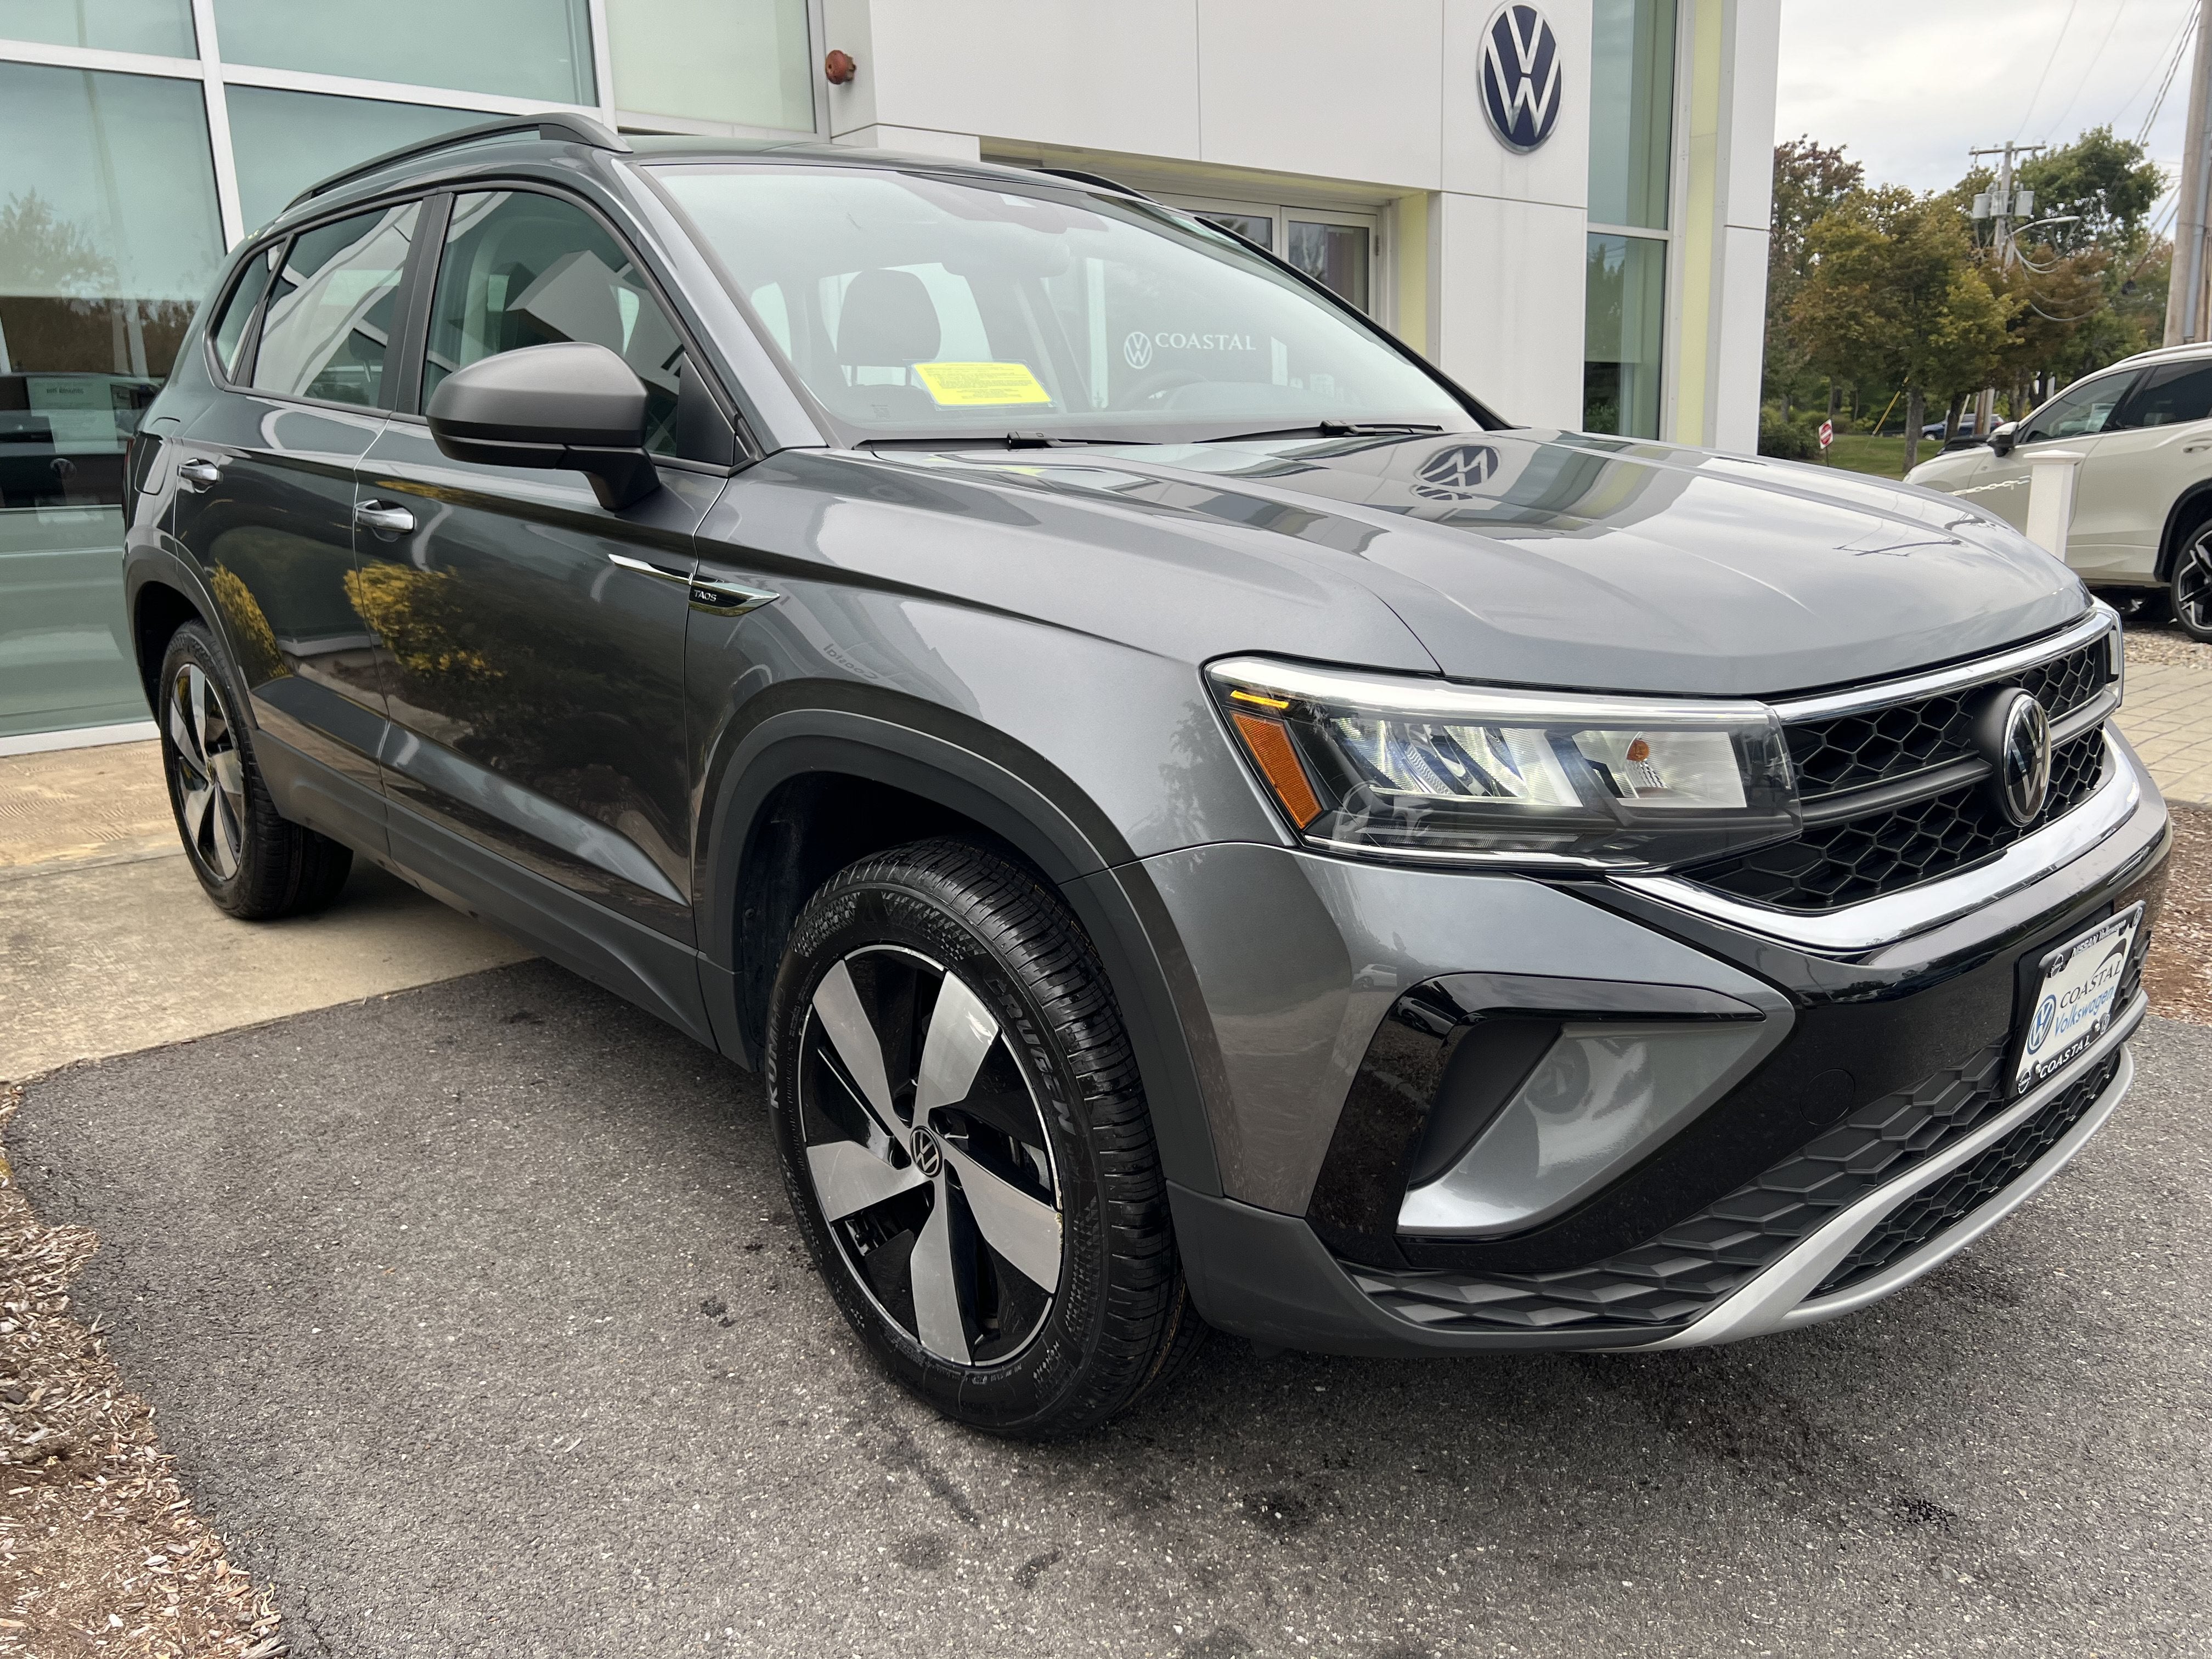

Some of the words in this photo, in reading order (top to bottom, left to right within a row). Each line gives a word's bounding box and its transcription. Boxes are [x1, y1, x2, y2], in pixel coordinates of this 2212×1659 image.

[1155, 332, 1256, 351] COASTAL
[693, 589, 717, 602] TAOS
[2059, 960, 2121, 1009] COASTAL
[2054, 985, 2115, 1039] Volkswagen
[768, 986, 786, 1110] KUMHO
[2039, 1035, 2092, 1079] COASTAL
